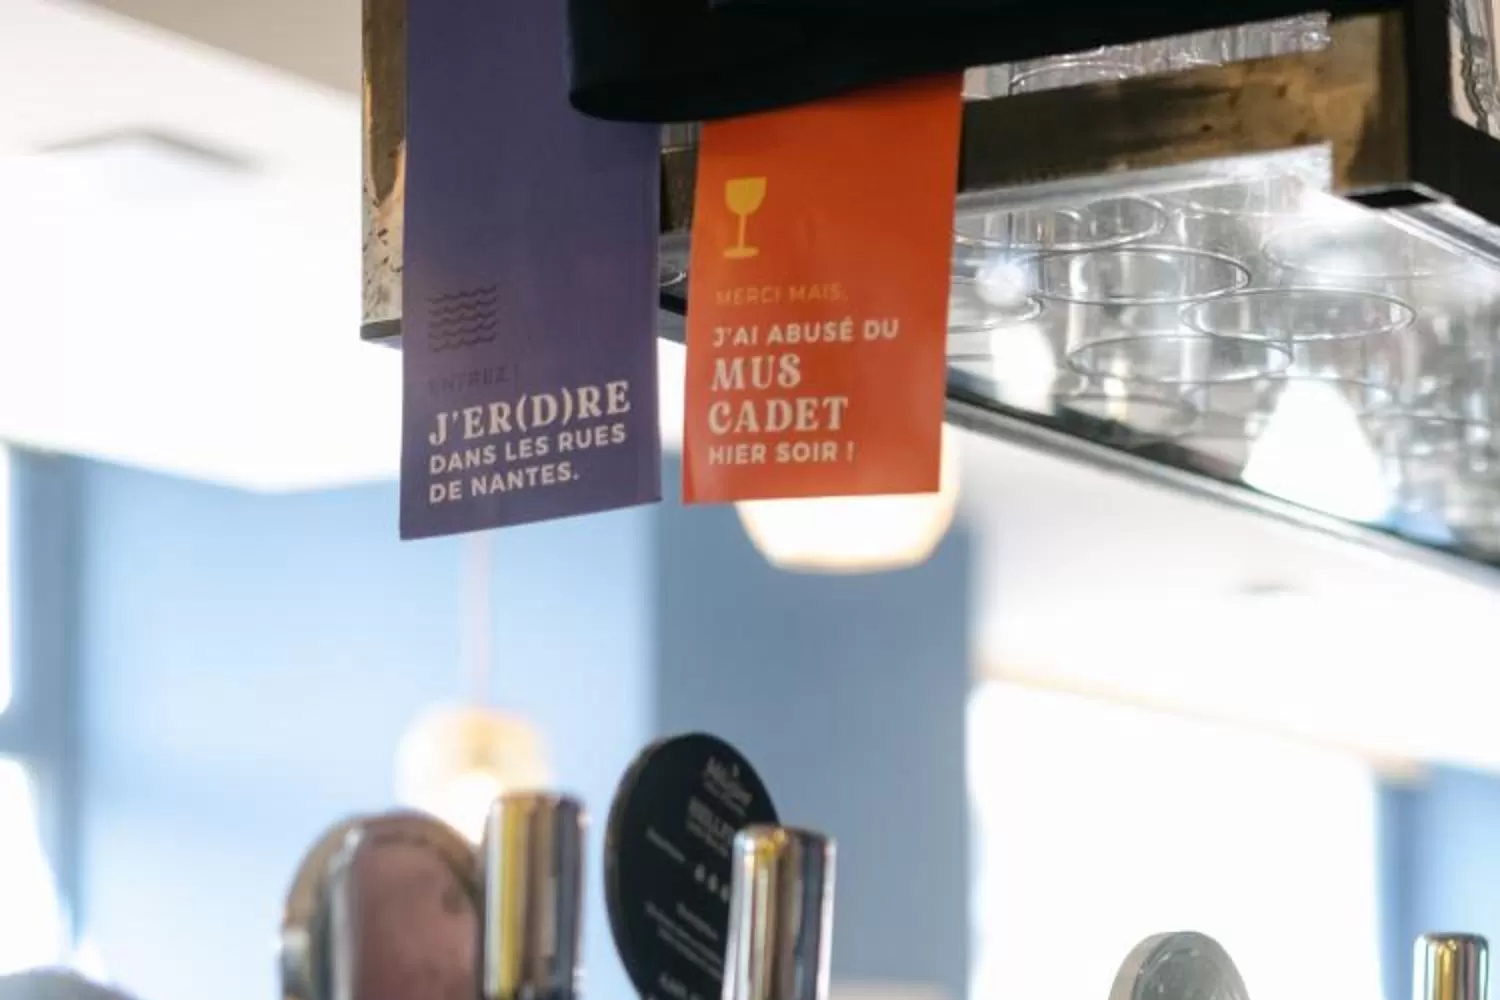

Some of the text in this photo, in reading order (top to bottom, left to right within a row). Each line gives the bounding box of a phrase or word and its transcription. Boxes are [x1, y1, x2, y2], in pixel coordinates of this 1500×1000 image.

[712, 315, 899, 348] J'AI ABUSÉ DU
[710, 352, 801, 393] MUS
[428, 379, 631, 447] J'ER(D)RE
[707, 395, 849, 436] CADET
[429, 423, 626, 476] DANS LES RUES
[709, 439, 855, 466] HIER SOIR !
[428, 461, 581, 505] DE NANTES.
